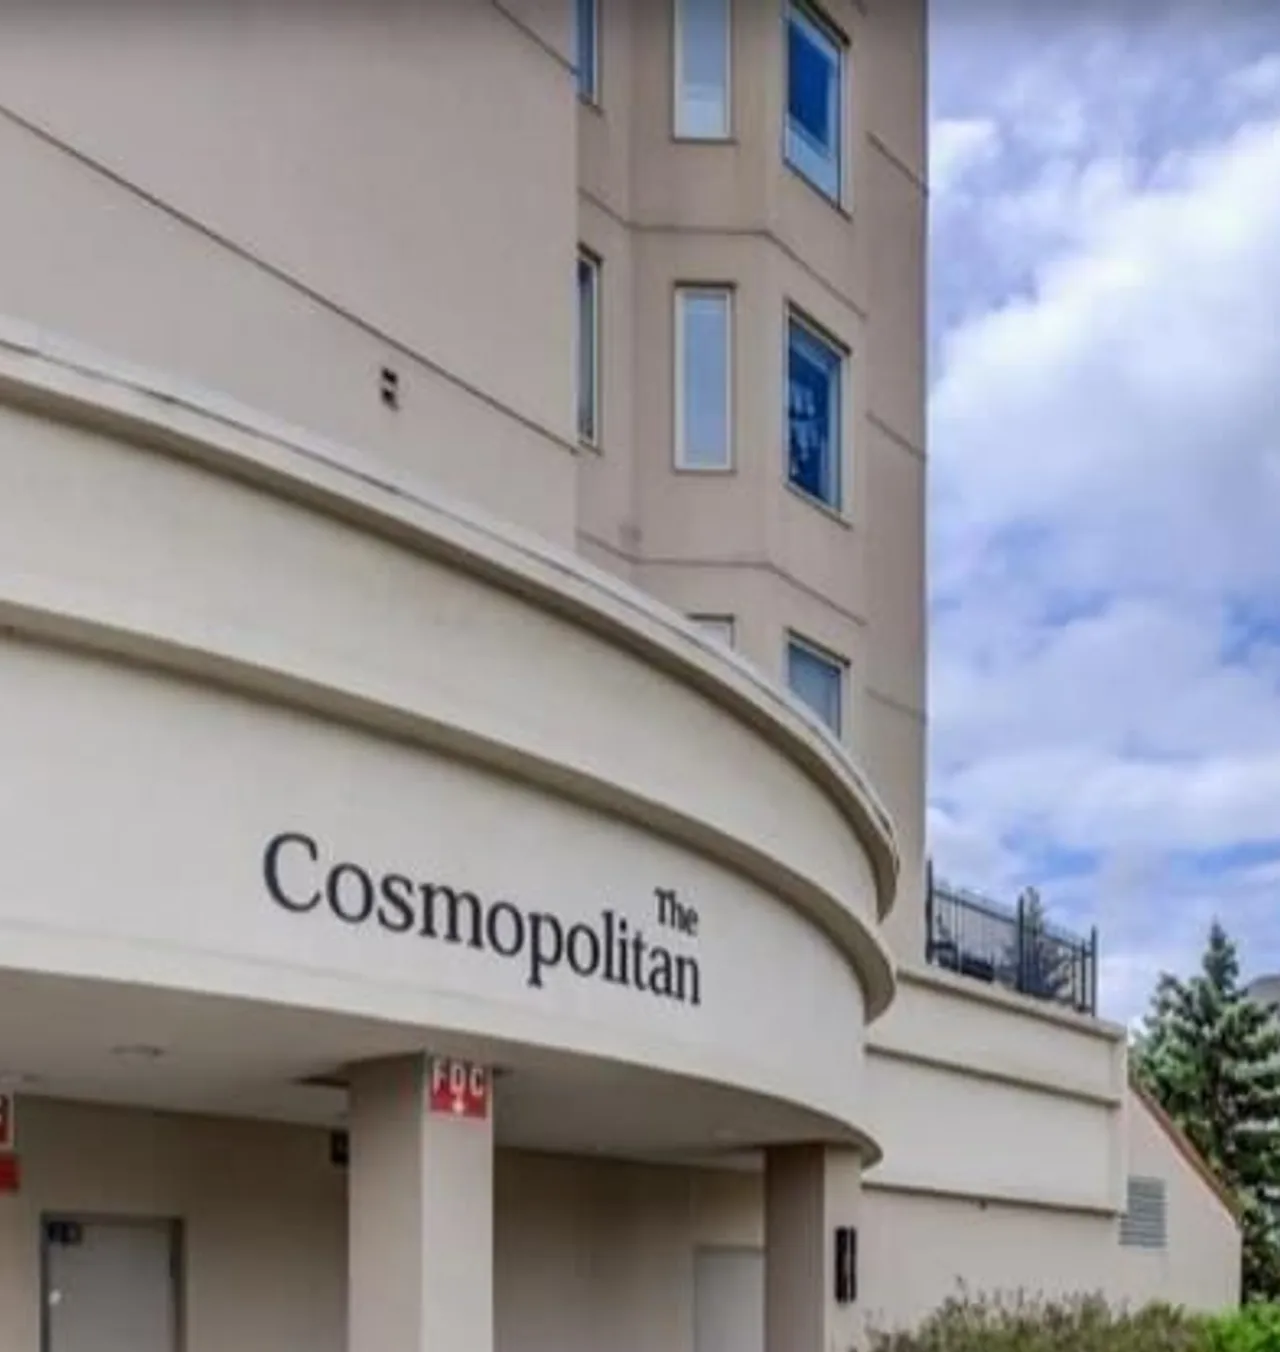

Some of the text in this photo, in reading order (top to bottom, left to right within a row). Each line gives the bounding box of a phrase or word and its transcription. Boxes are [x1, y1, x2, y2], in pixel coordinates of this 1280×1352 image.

[263, 832, 701, 1005] Cosmopolitan
[654, 888, 698, 936] The
[433, 1059, 484, 1098] FDC
